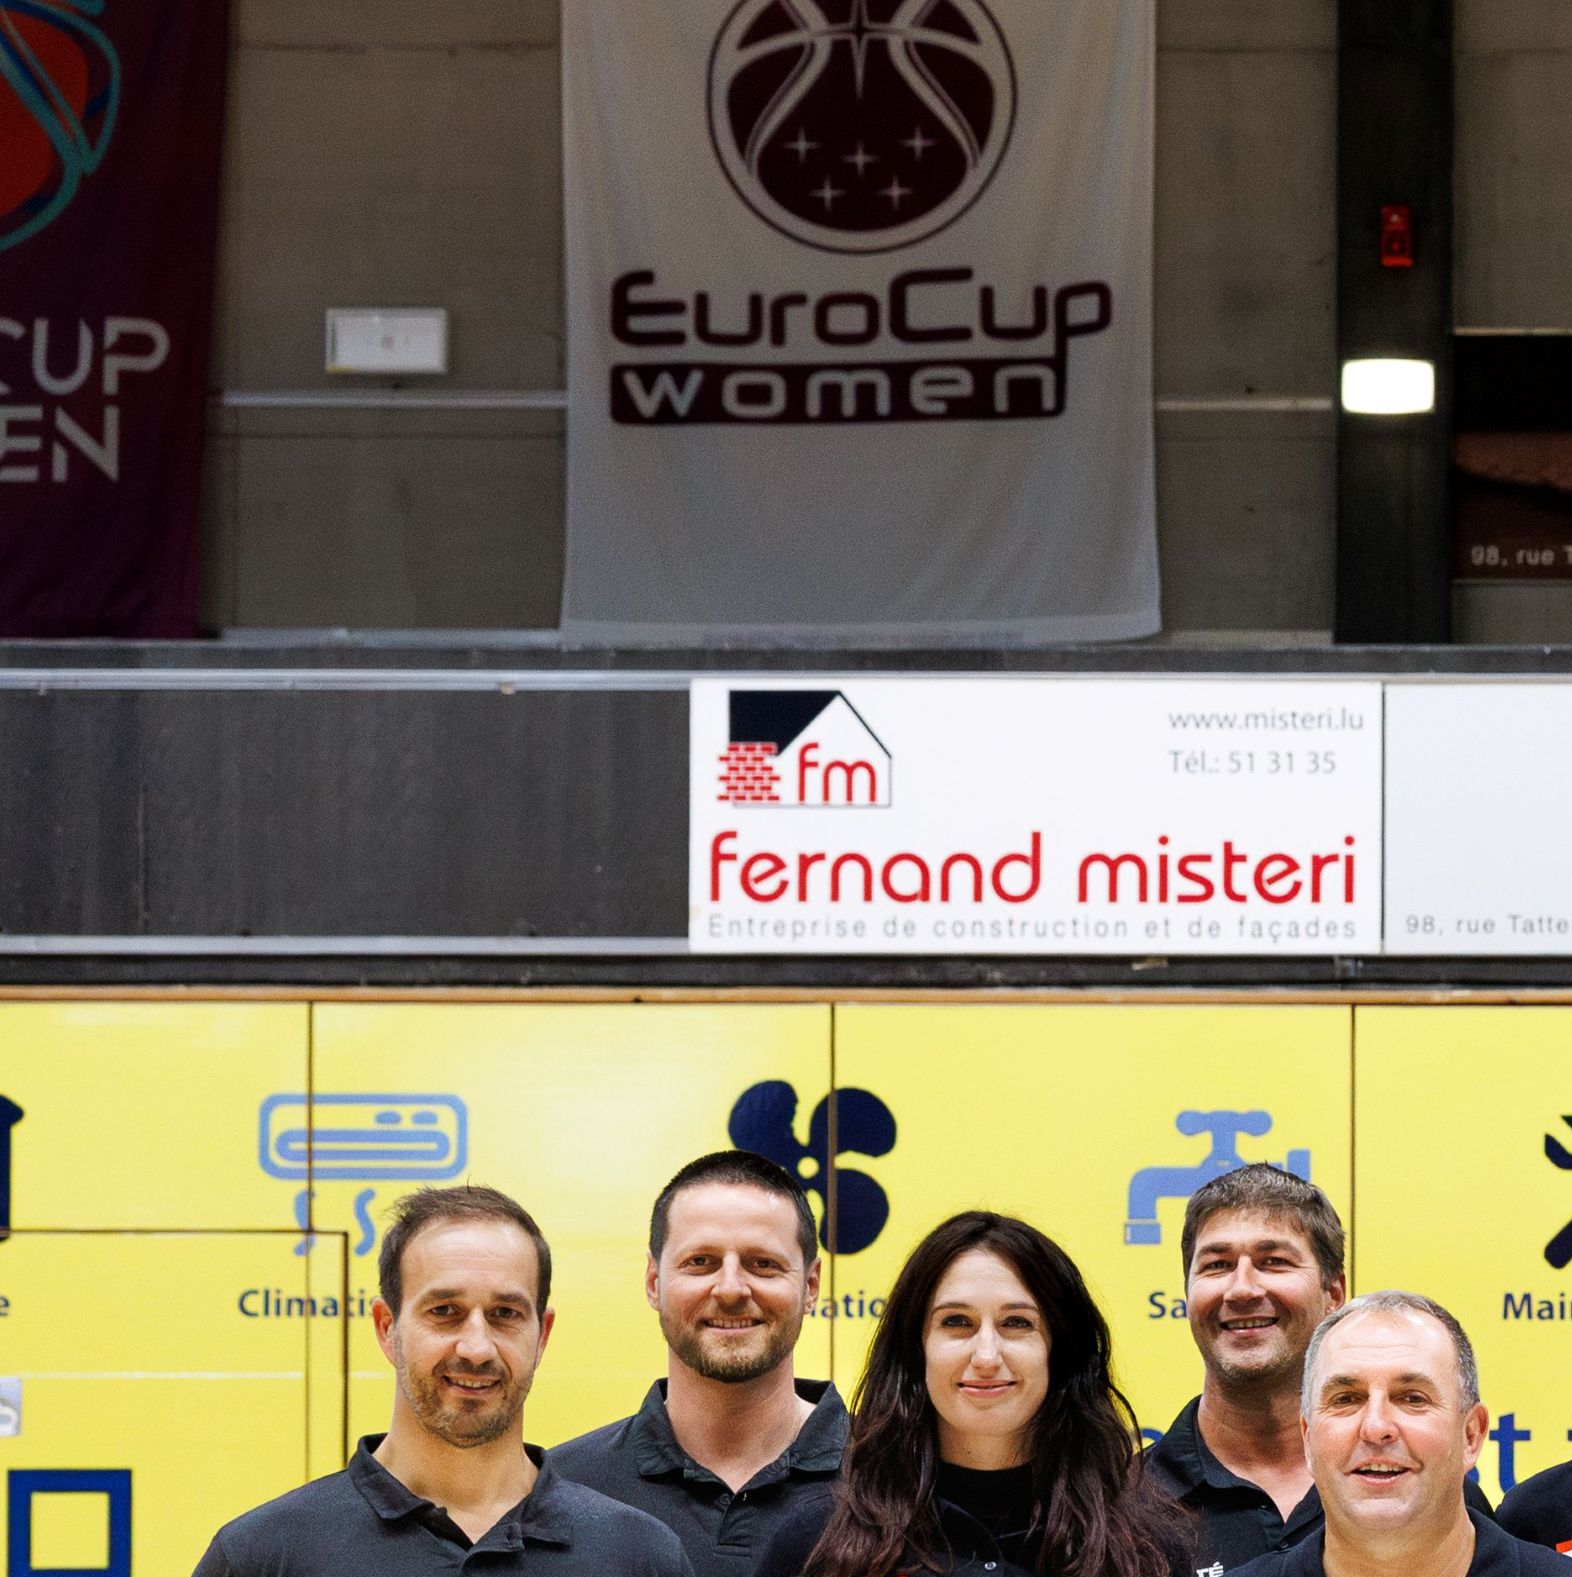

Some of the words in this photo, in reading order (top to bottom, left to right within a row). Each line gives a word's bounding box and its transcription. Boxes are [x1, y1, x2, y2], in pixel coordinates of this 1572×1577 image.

[1517, 549, 1553, 565] rue
[1168, 708, 1364, 731] www.misteri.lu
[799, 742, 877, 803] fm
[1228, 752, 1257, 774] 51
[1267, 752, 1296, 774] 31
[1307, 752, 1337, 774] 35
[710, 831, 1042, 903] fernand
[1078, 835, 1356, 903] misteri
[709, 914, 867, 943] Entreprise
[883, 914, 917, 938] de
[933, 914, 1129, 938] construction
[1145, 917, 1172, 938] et
[1188, 914, 1222, 938] de
[1237, 914, 1357, 943] façades
[1406, 914, 1444, 938] 98,
[1455, 920, 1496, 935] rue
